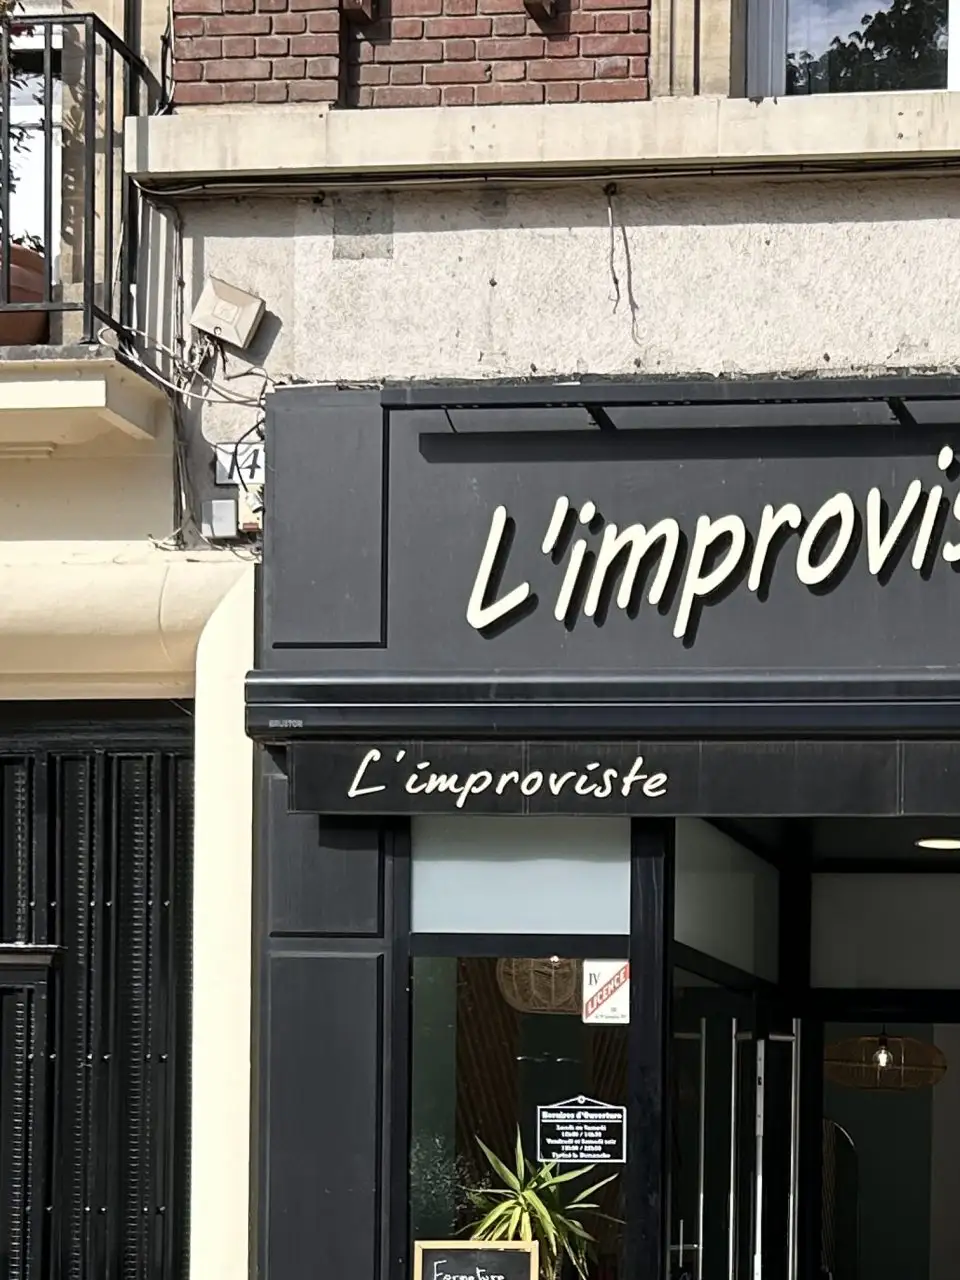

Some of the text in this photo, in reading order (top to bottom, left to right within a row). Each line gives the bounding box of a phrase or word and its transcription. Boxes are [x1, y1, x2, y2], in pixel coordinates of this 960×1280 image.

[217, 448, 261, 480] 14
[347, 748, 668, 808] L'improviste
[587, 965, 627, 1015] LICENCE
[588, 972, 600, 986] IV
